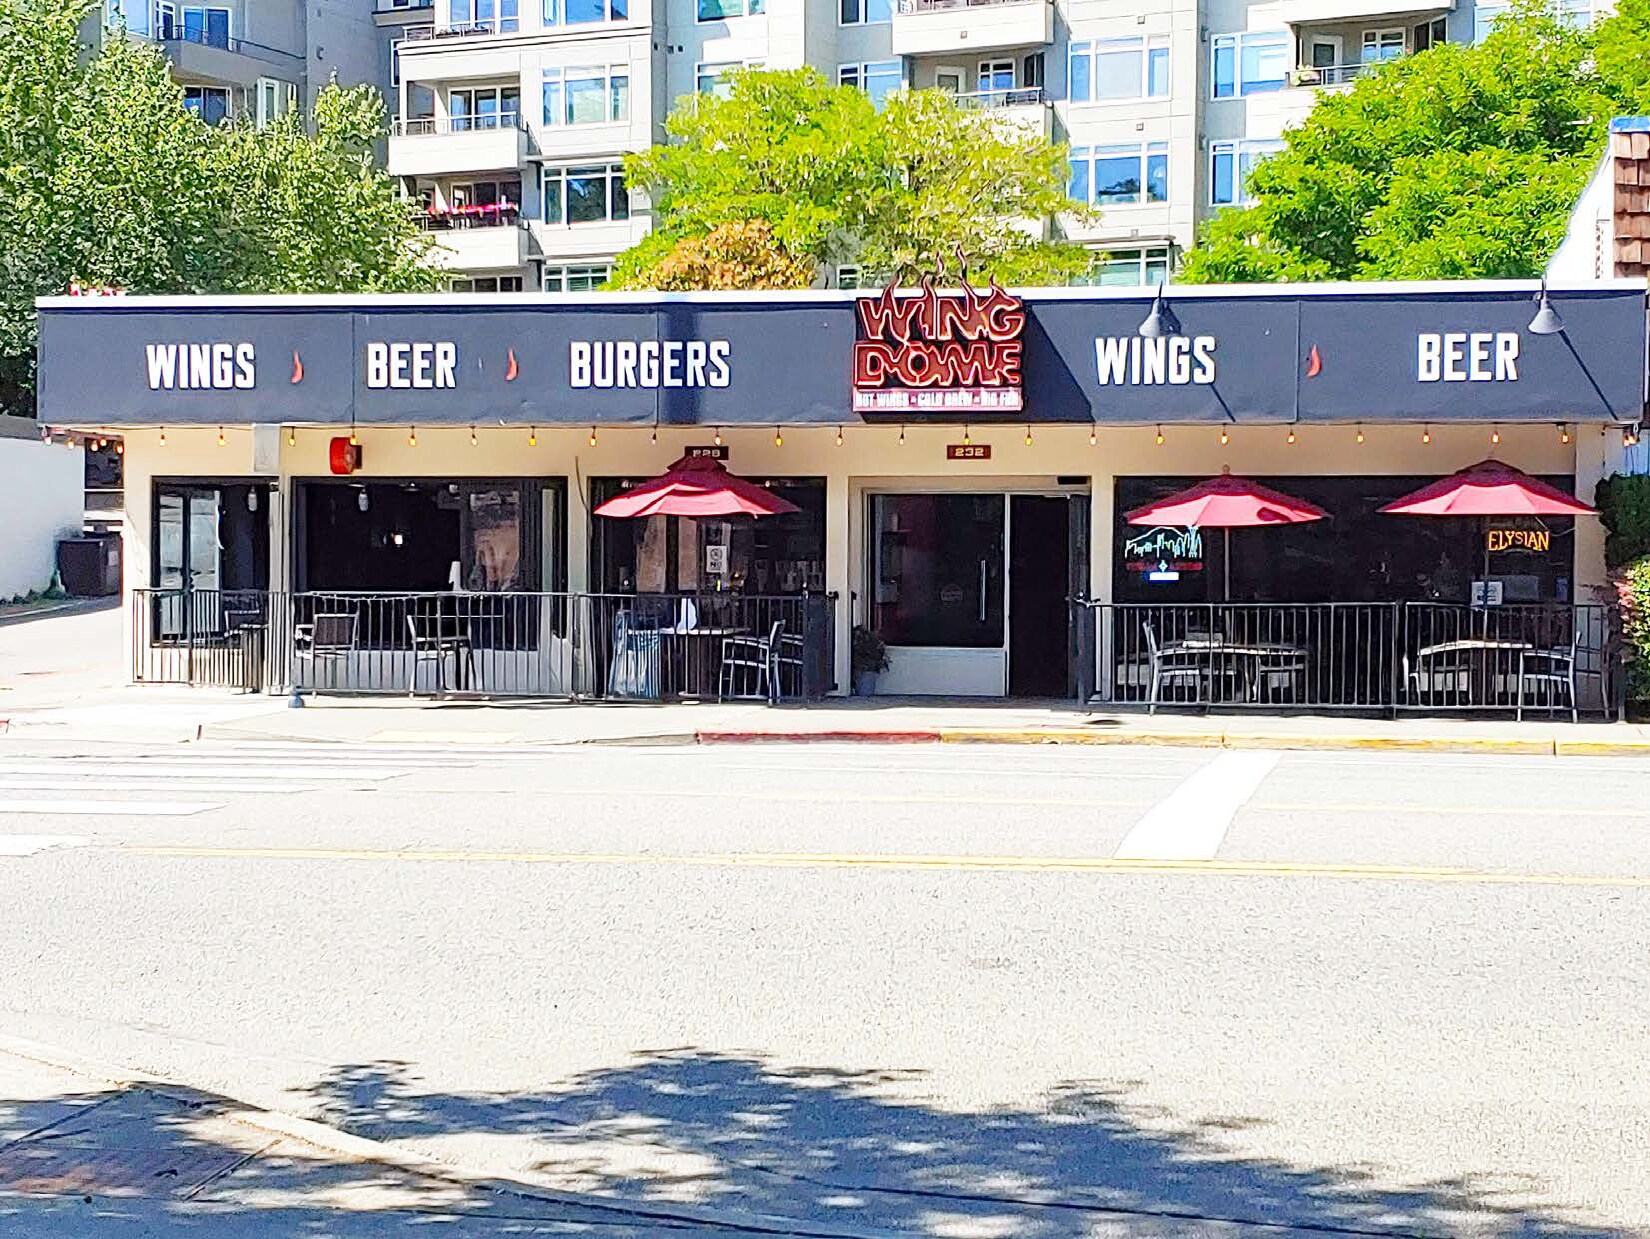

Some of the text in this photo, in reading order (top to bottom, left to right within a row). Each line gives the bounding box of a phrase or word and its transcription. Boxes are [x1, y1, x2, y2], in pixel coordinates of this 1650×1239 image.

[858, 284, 1025, 341] WING
[145, 342, 256, 390] WINGS
[366, 341, 458, 389] BEER
[569, 339, 731, 389] BURGERS
[852, 341, 1023, 387] DOME
[1095, 334, 1216, 387] WINGS
[1417, 331, 1520, 383] BEER
[955, 447, 984, 457] 232
[1488, 530, 1550, 551] ELYSIAN
